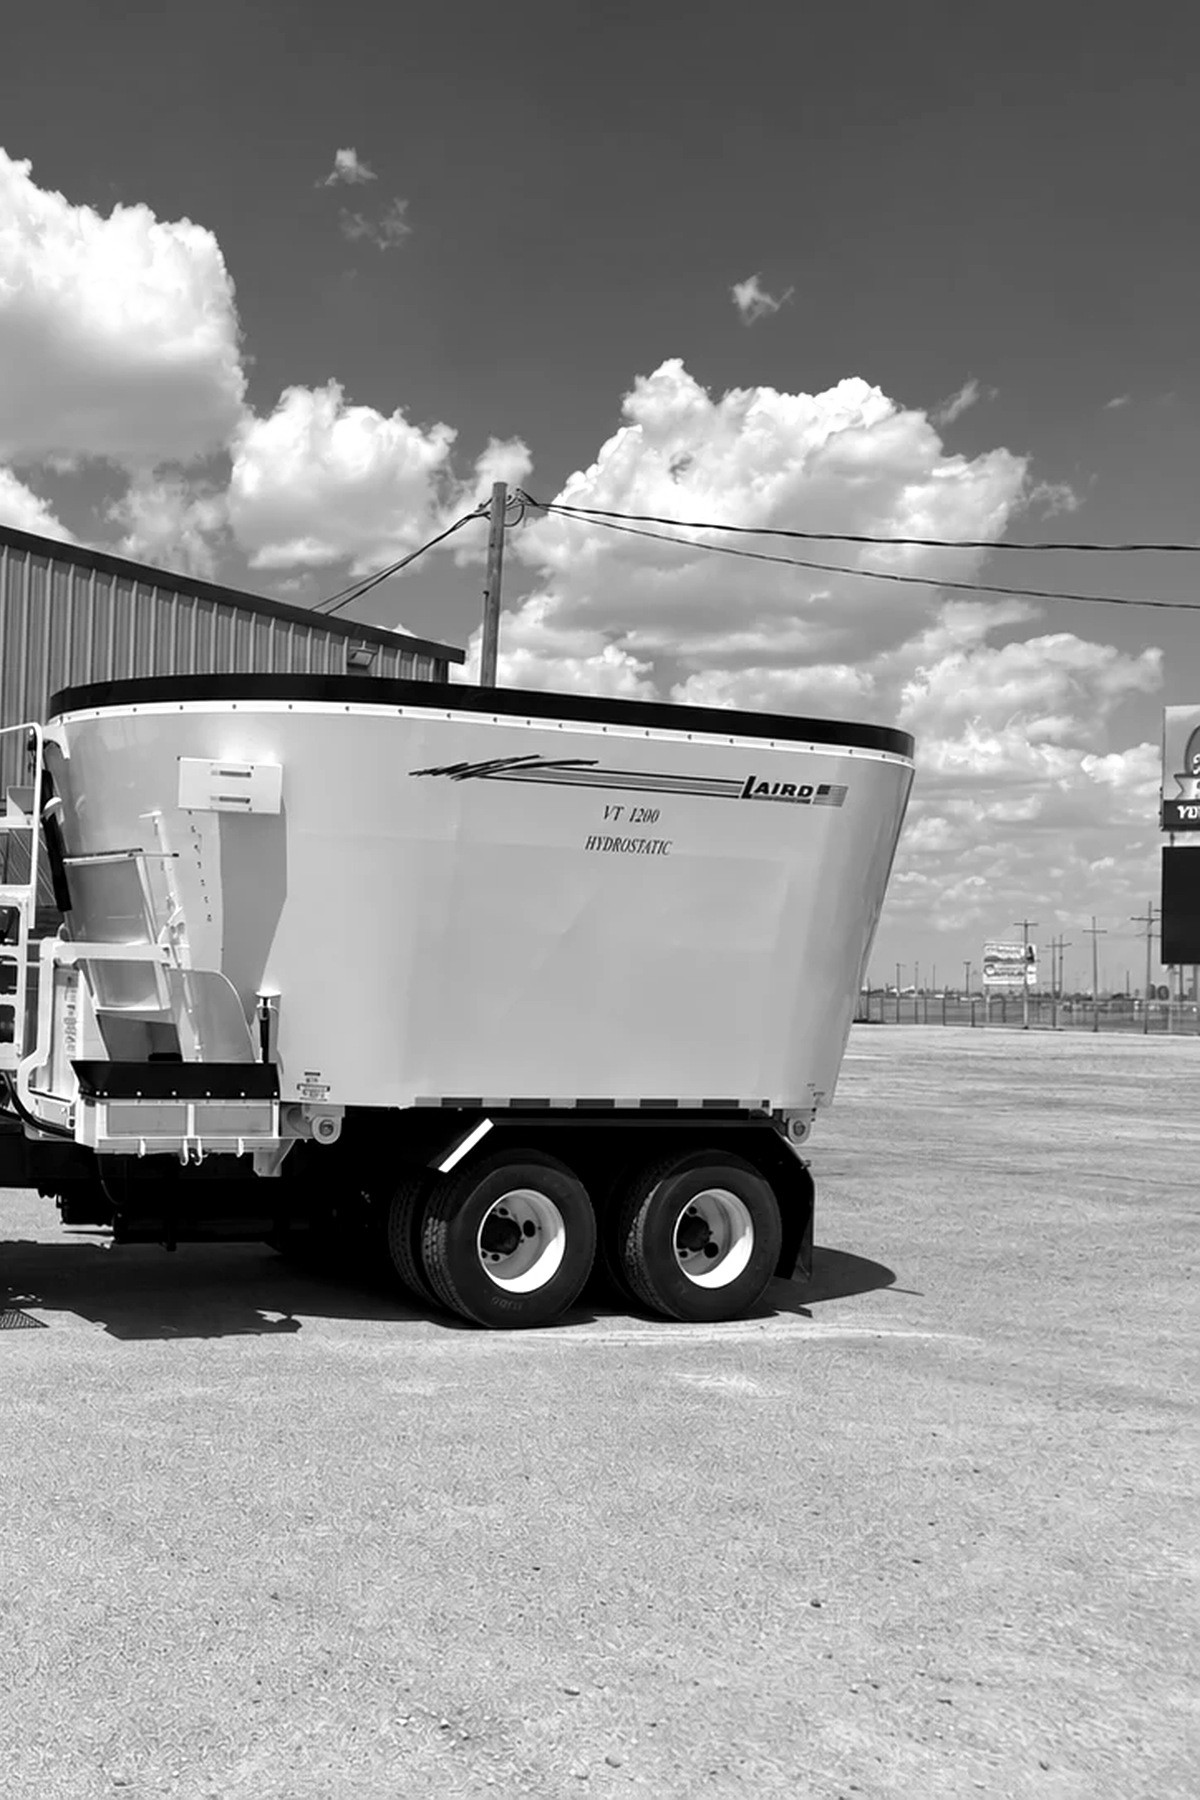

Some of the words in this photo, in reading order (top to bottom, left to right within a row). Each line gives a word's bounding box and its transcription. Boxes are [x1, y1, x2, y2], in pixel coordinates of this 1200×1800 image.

[741, 775, 814, 799] LAIRD
[603, 805, 625, 821] VT
[629, 807, 661, 824] 1200
[1177, 805, 1200, 819] YO
[584, 835, 673, 855] HYDROSTATIC
